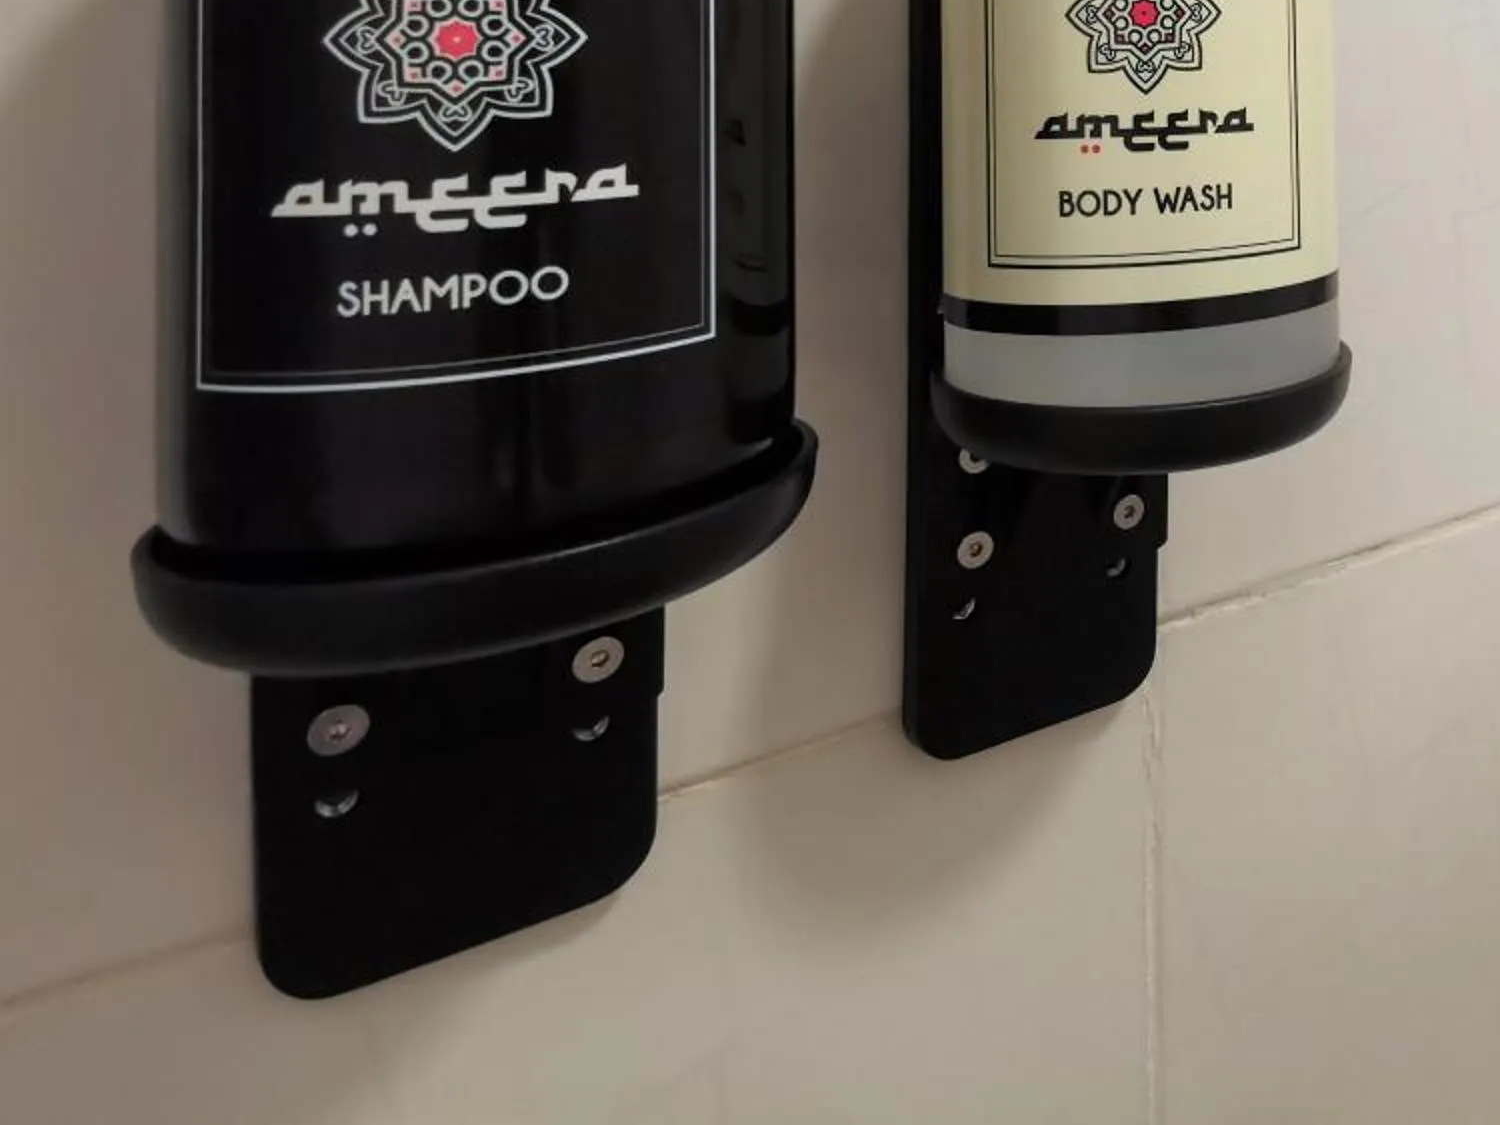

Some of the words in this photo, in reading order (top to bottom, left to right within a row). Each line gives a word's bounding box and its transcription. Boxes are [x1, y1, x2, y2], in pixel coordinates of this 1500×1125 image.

[1058, 187, 1144, 218] BODY
[1153, 182, 1233, 215] WASH
[336, 265, 570, 318] SHAMPOO
